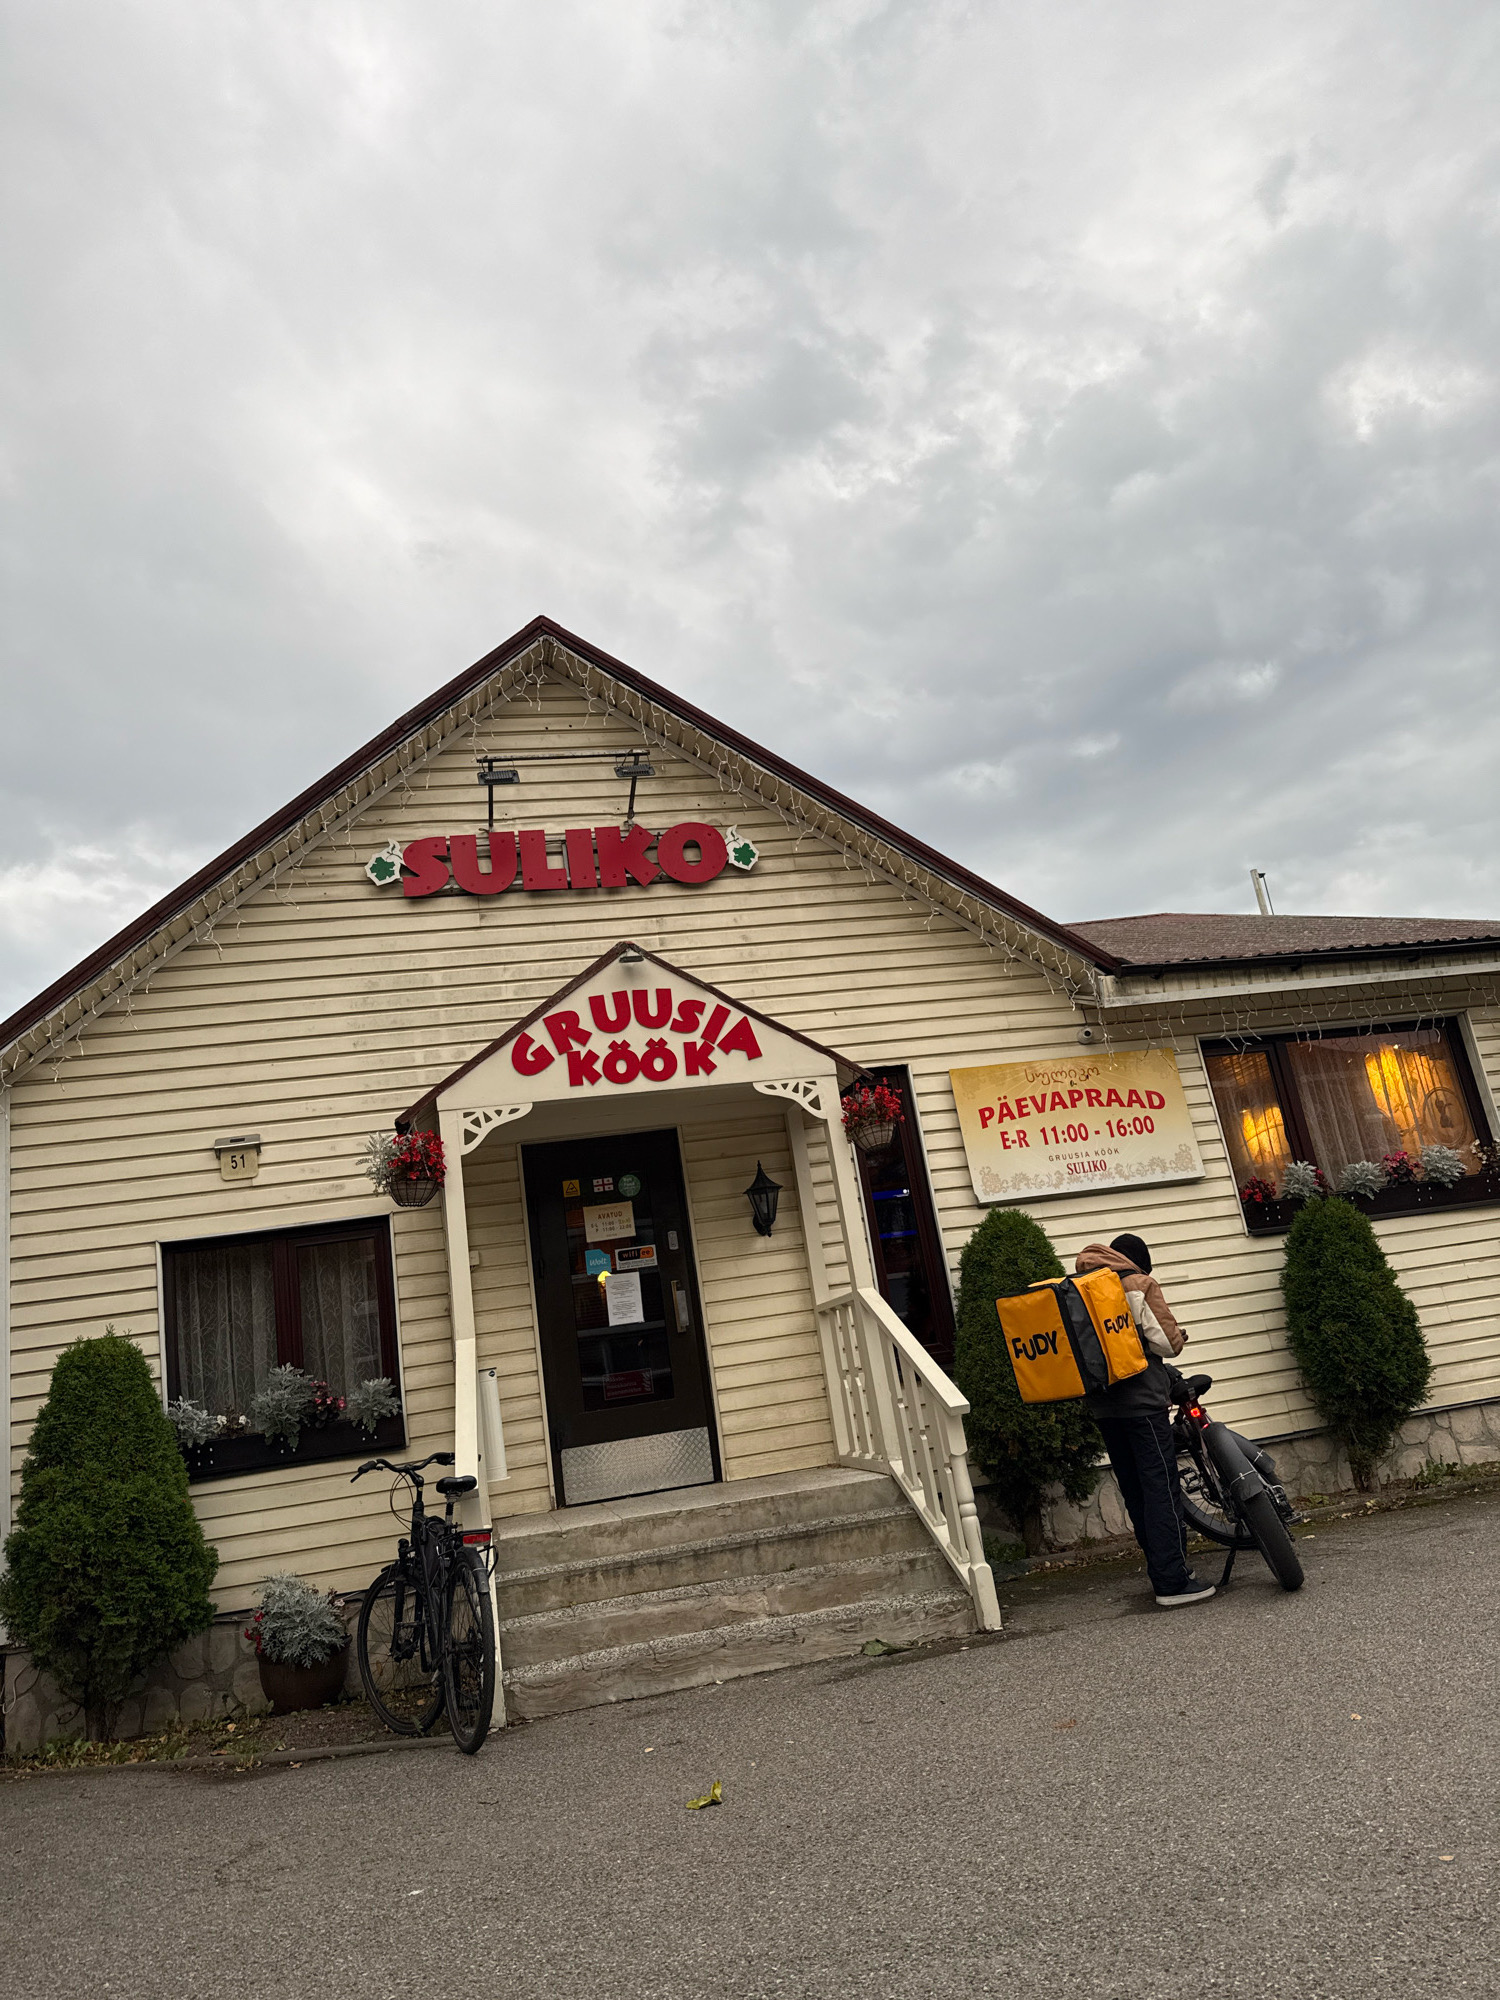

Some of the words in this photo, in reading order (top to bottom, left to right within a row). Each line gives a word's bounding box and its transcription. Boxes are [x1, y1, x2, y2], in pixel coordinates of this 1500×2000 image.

[402, 821, 728, 898] SULIKO
[511, 987, 763, 1077] GRUUSIA
[567, 1037, 718, 1088] KÖÖK
[977, 1087, 1166, 1130] PÄEVAPRAAD
[1000, 1128, 1031, 1151] E-R
[1039, 1122, 1090, 1146] 11:00
[1104, 1114, 1156, 1139] 16:00
[230, 1153, 246, 1170] 51
[1048, 1151, 1091, 1163] GRUUSIA
[1094, 1147, 1120, 1158] KÖÖK
[1066, 1159, 1107, 1176] SULIKO
[597, 1211, 623, 1220] AVATUD
[589, 1257, 607, 1266] Wolt
[1104, 1312, 1131, 1335] FUDY
[1011, 1330, 1058, 1362] FUDY
